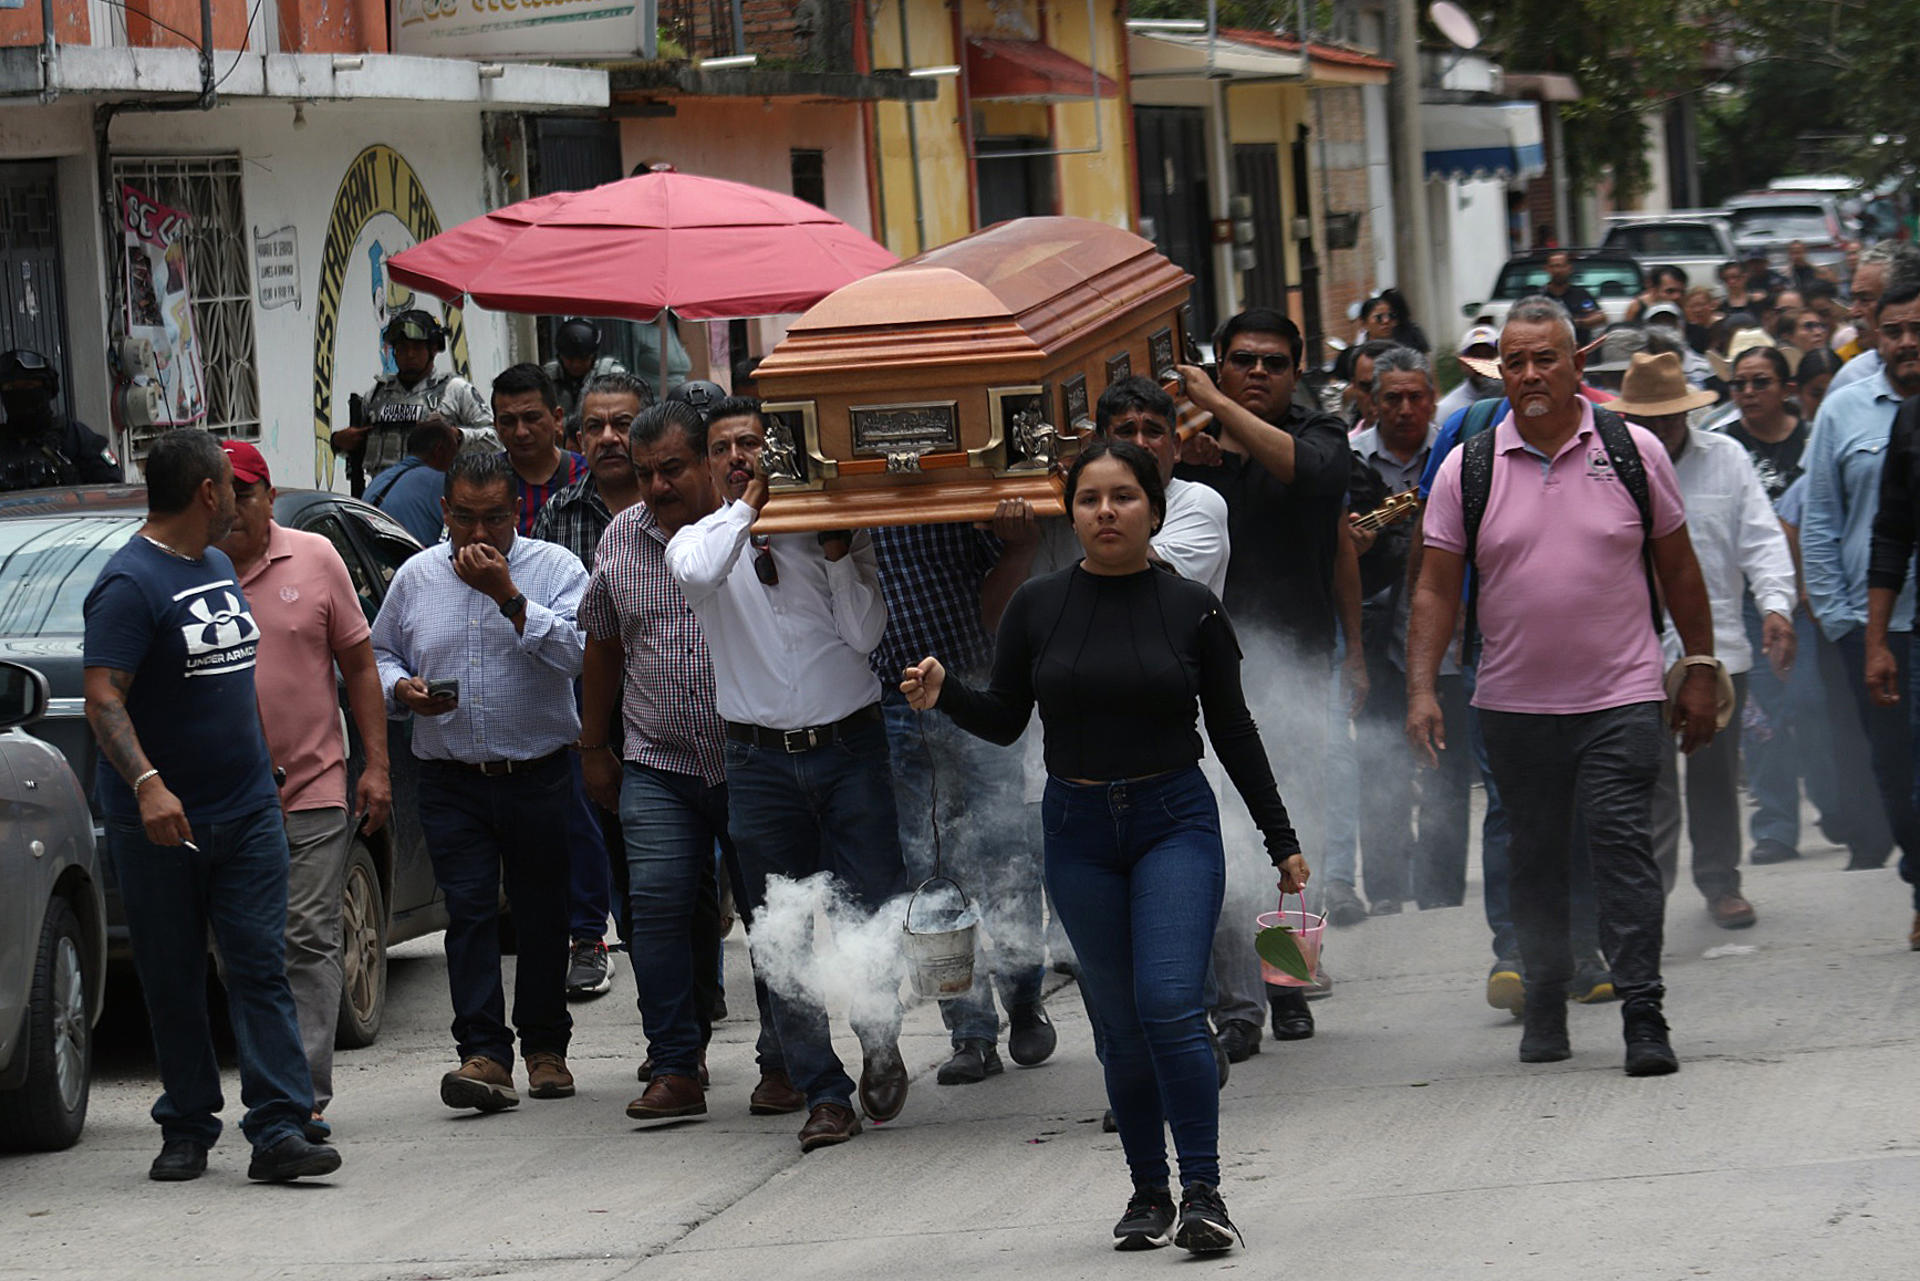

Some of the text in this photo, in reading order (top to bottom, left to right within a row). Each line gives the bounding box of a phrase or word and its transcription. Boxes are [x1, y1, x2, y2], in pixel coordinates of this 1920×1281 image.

[314, 151, 379, 428] RESTAURANT
[388, 152, 399, 210] Y
[384, 404, 417, 415] GUARDIA
[187, 654, 225, 667] UNDER
